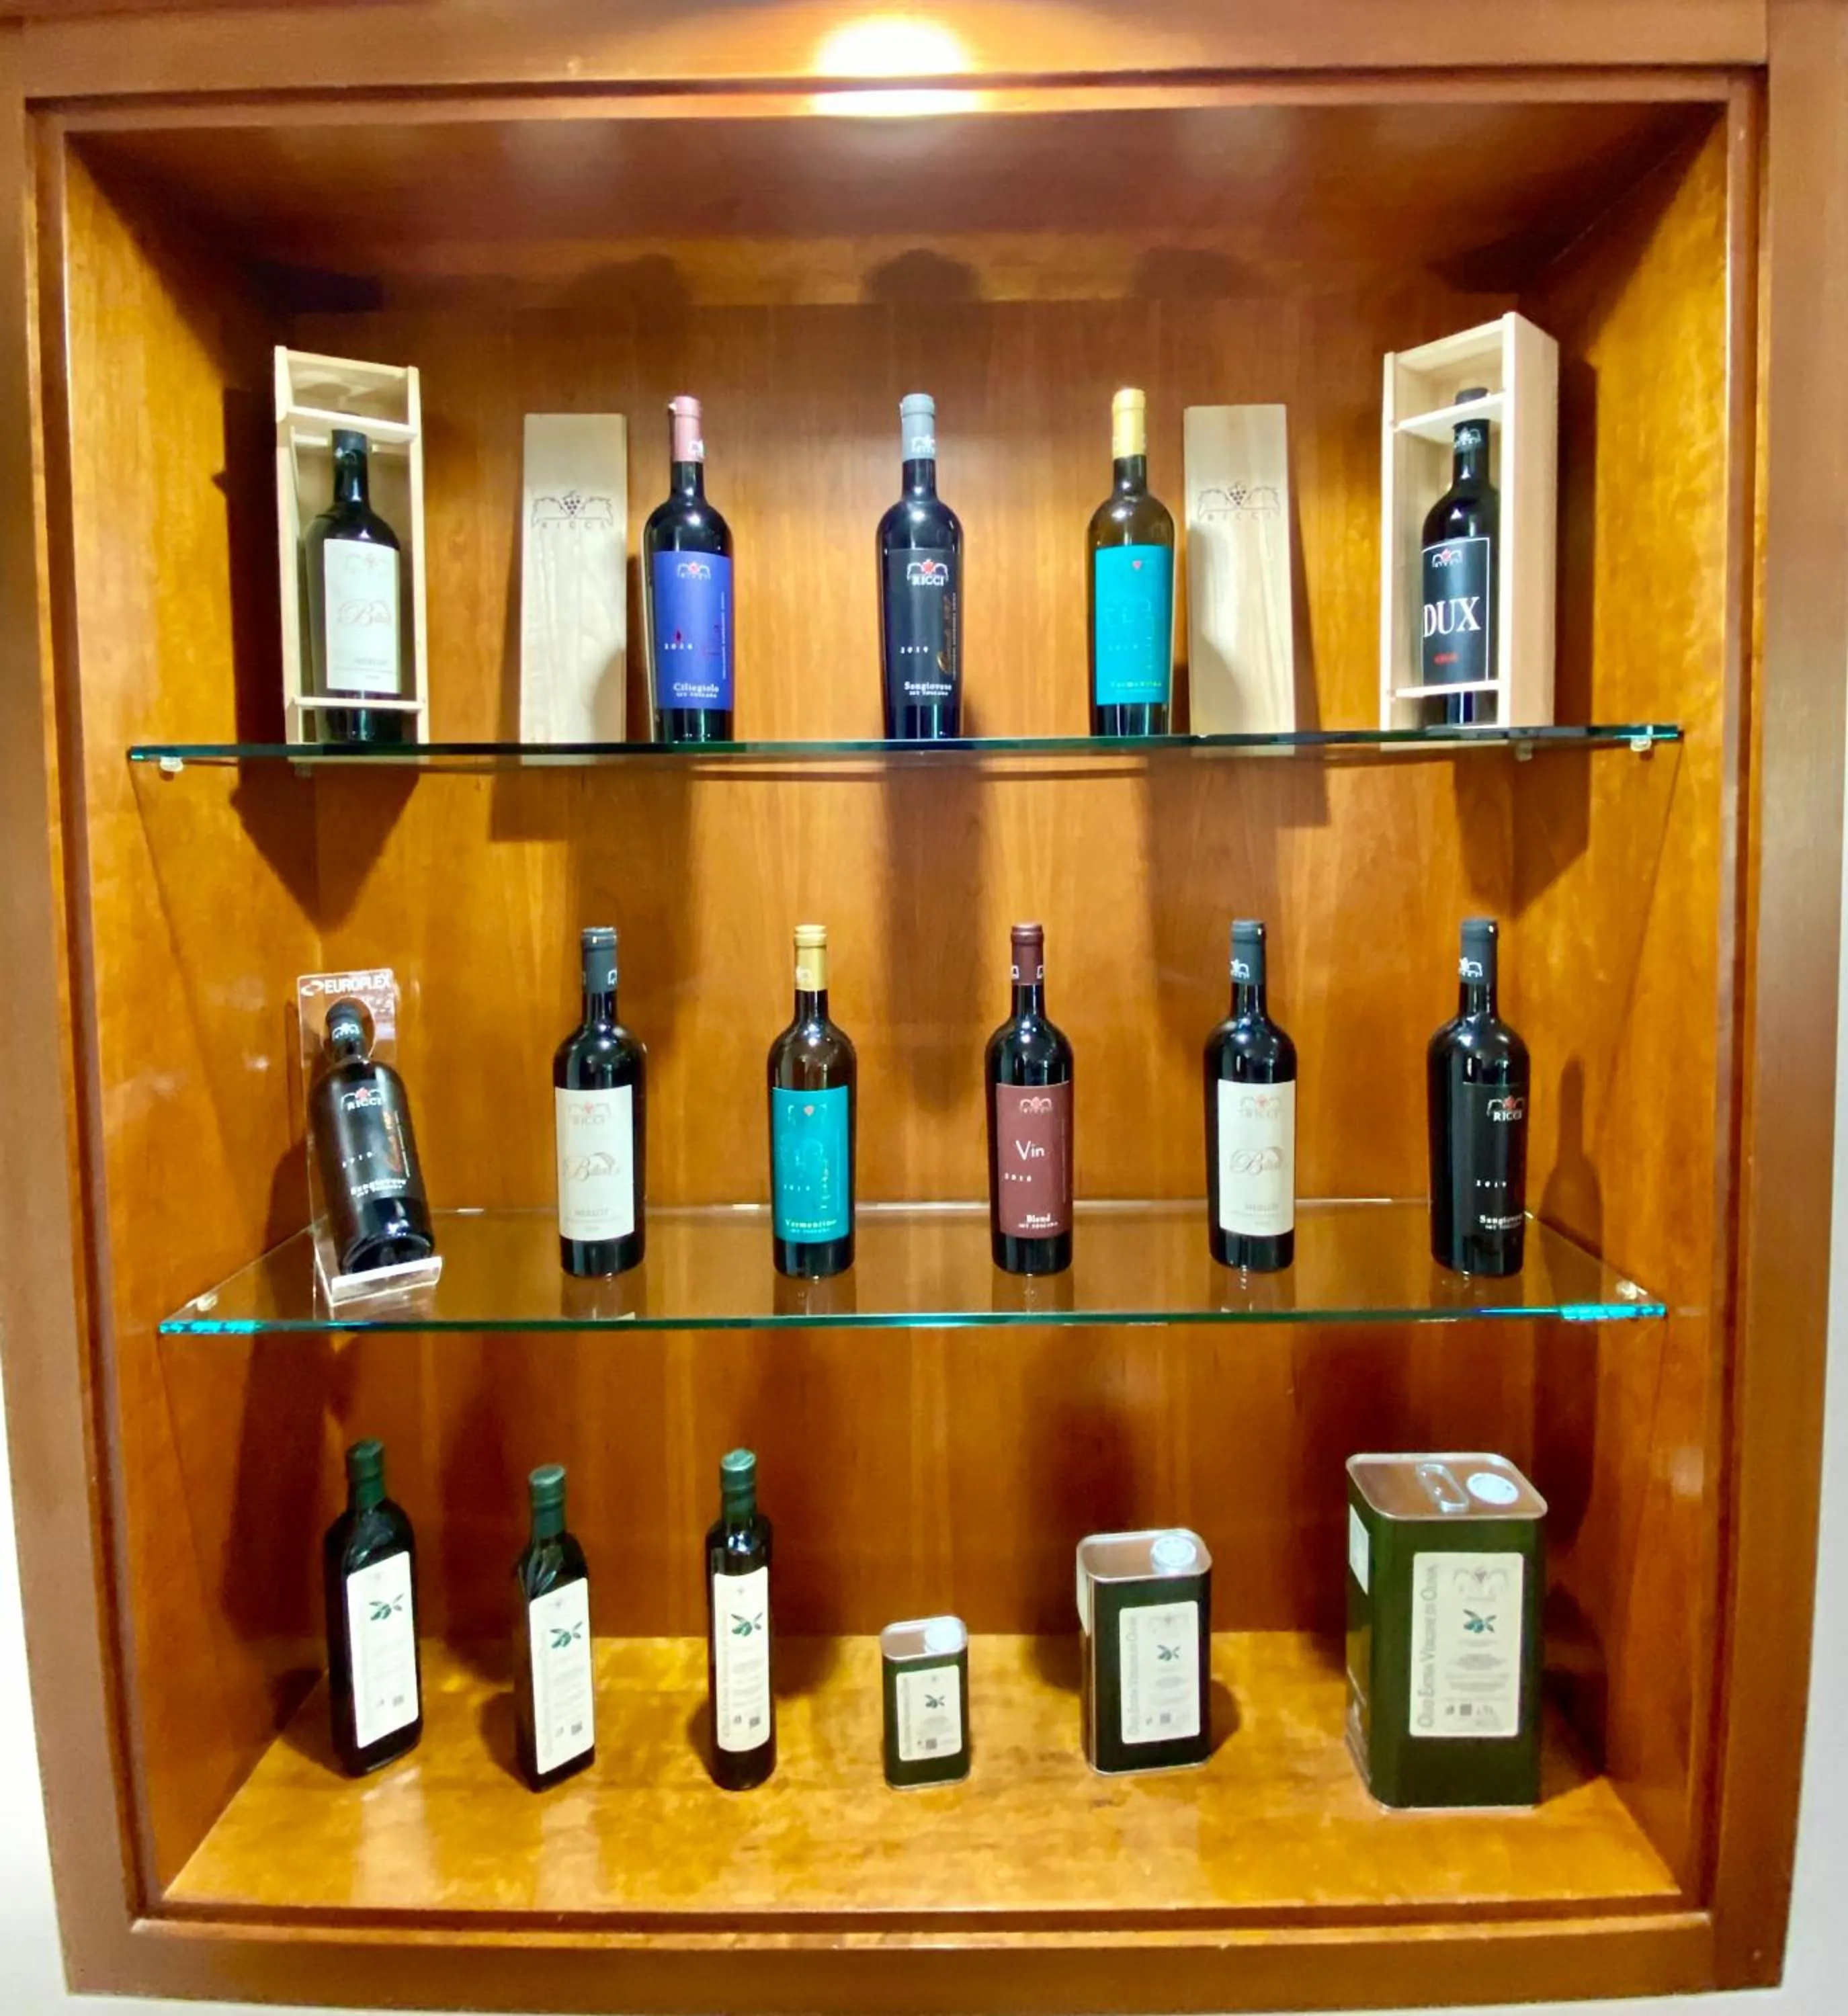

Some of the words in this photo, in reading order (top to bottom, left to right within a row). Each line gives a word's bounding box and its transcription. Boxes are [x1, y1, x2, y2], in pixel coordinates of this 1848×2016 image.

[911, 575, 944, 586] RICCI
[1423, 596, 1481, 638] DUX
[324, 972, 391, 995] EUROPLEX
[347, 1097, 382, 1111] RICCI
[1015, 1140, 1046, 1161] Vin
[785, 1218, 837, 1228] Vermentino
[1026, 1213, 1050, 1223] Blend
